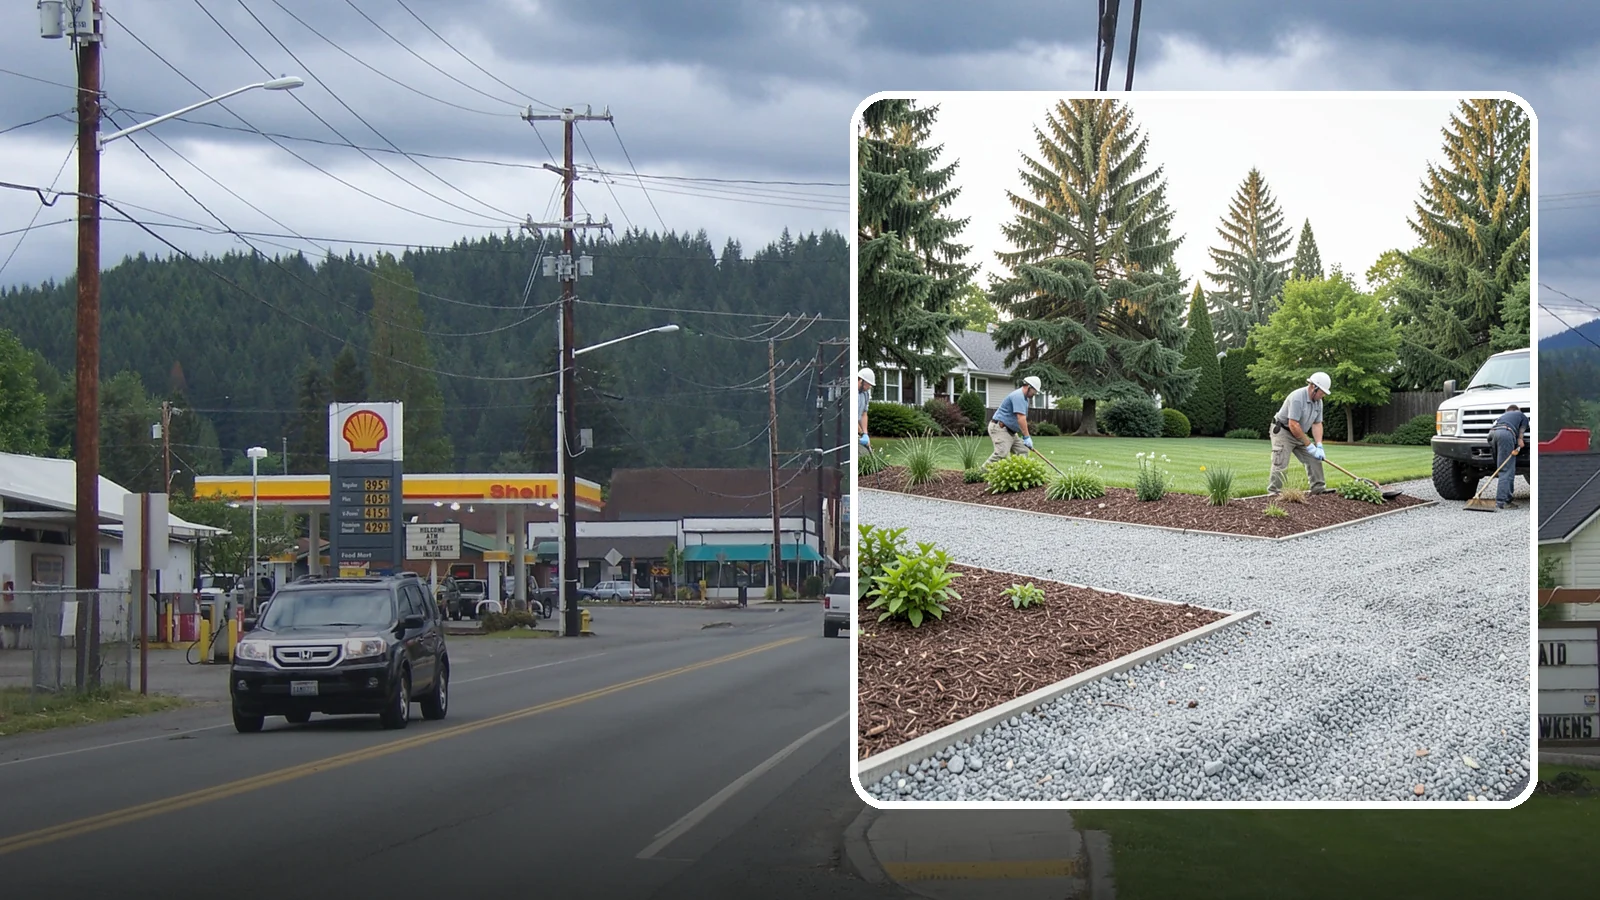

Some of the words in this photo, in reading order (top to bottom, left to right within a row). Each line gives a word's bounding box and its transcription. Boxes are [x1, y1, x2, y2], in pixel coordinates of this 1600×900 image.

[366, 480, 383, 490] 395
[490, 484, 547, 499] Shell
[366, 494, 383, 504] 405
[366, 508, 383, 518] 415
[366, 522, 383, 532] 429
